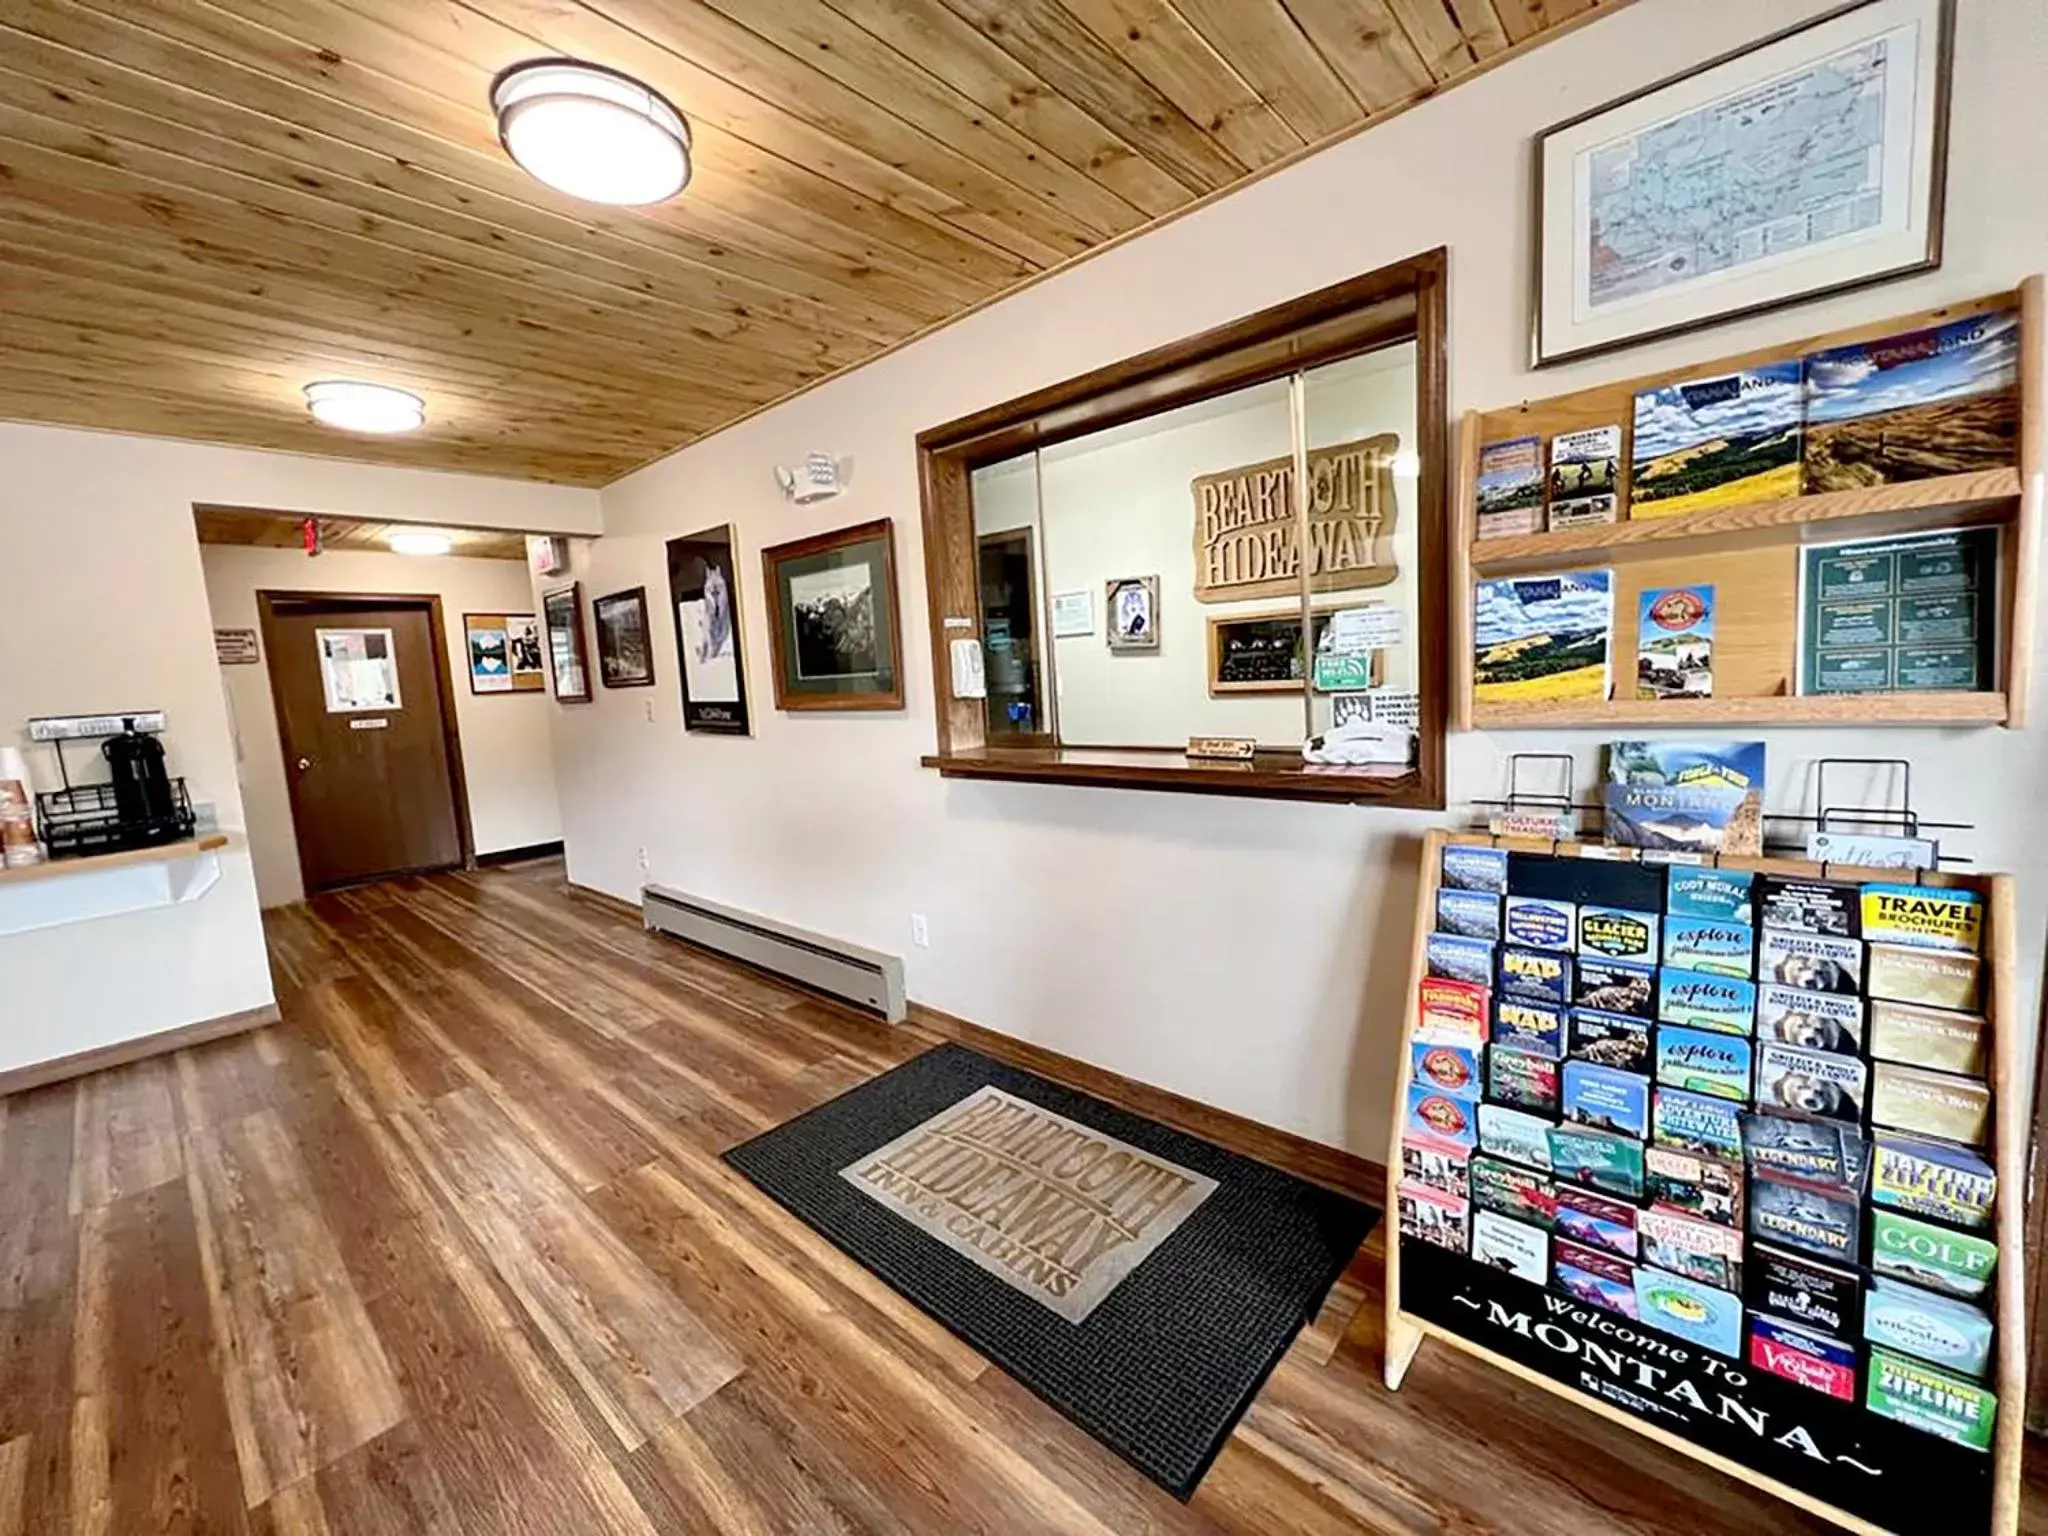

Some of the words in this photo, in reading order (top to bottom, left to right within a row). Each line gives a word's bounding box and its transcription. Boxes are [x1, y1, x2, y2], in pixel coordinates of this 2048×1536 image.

[1202, 448, 1381, 548] BEARTOTH
[1204, 519, 1381, 588] HIDEAWAY
[1878, 895, 1977, 922] TRAVEL
[1878, 911, 1974, 932] BROCHURES
[1583, 919, 1647, 940] GLACIER
[1676, 927, 1744, 948] explore
[1503, 953, 1562, 979] MAP
[1670, 983, 1738, 1002] explore
[1499, 1001, 1558, 1033] MAP
[1667, 1044, 1737, 1063] explore
[926, 1094, 1197, 1240] BEARTOOTH
[1751, 1145, 1838, 1173] LEGENDARY
[877, 1131, 1133, 1277] HIDEAWAY
[857, 1162, 922, 1206] INN
[918, 1199, 942, 1219] &
[945, 1213, 1081, 1299] CABINS
[1759, 1211, 1848, 1249] LEGENDARY
[1881, 1226, 1990, 1270] GOLF
[1543, 1294, 1689, 1363] Welcome
[1485, 1299, 1831, 1464] MONTANA
[1879, 1373, 1980, 1420] ZIPLINE
[1880, 1360, 1980, 1403] YELLOWSTONE
